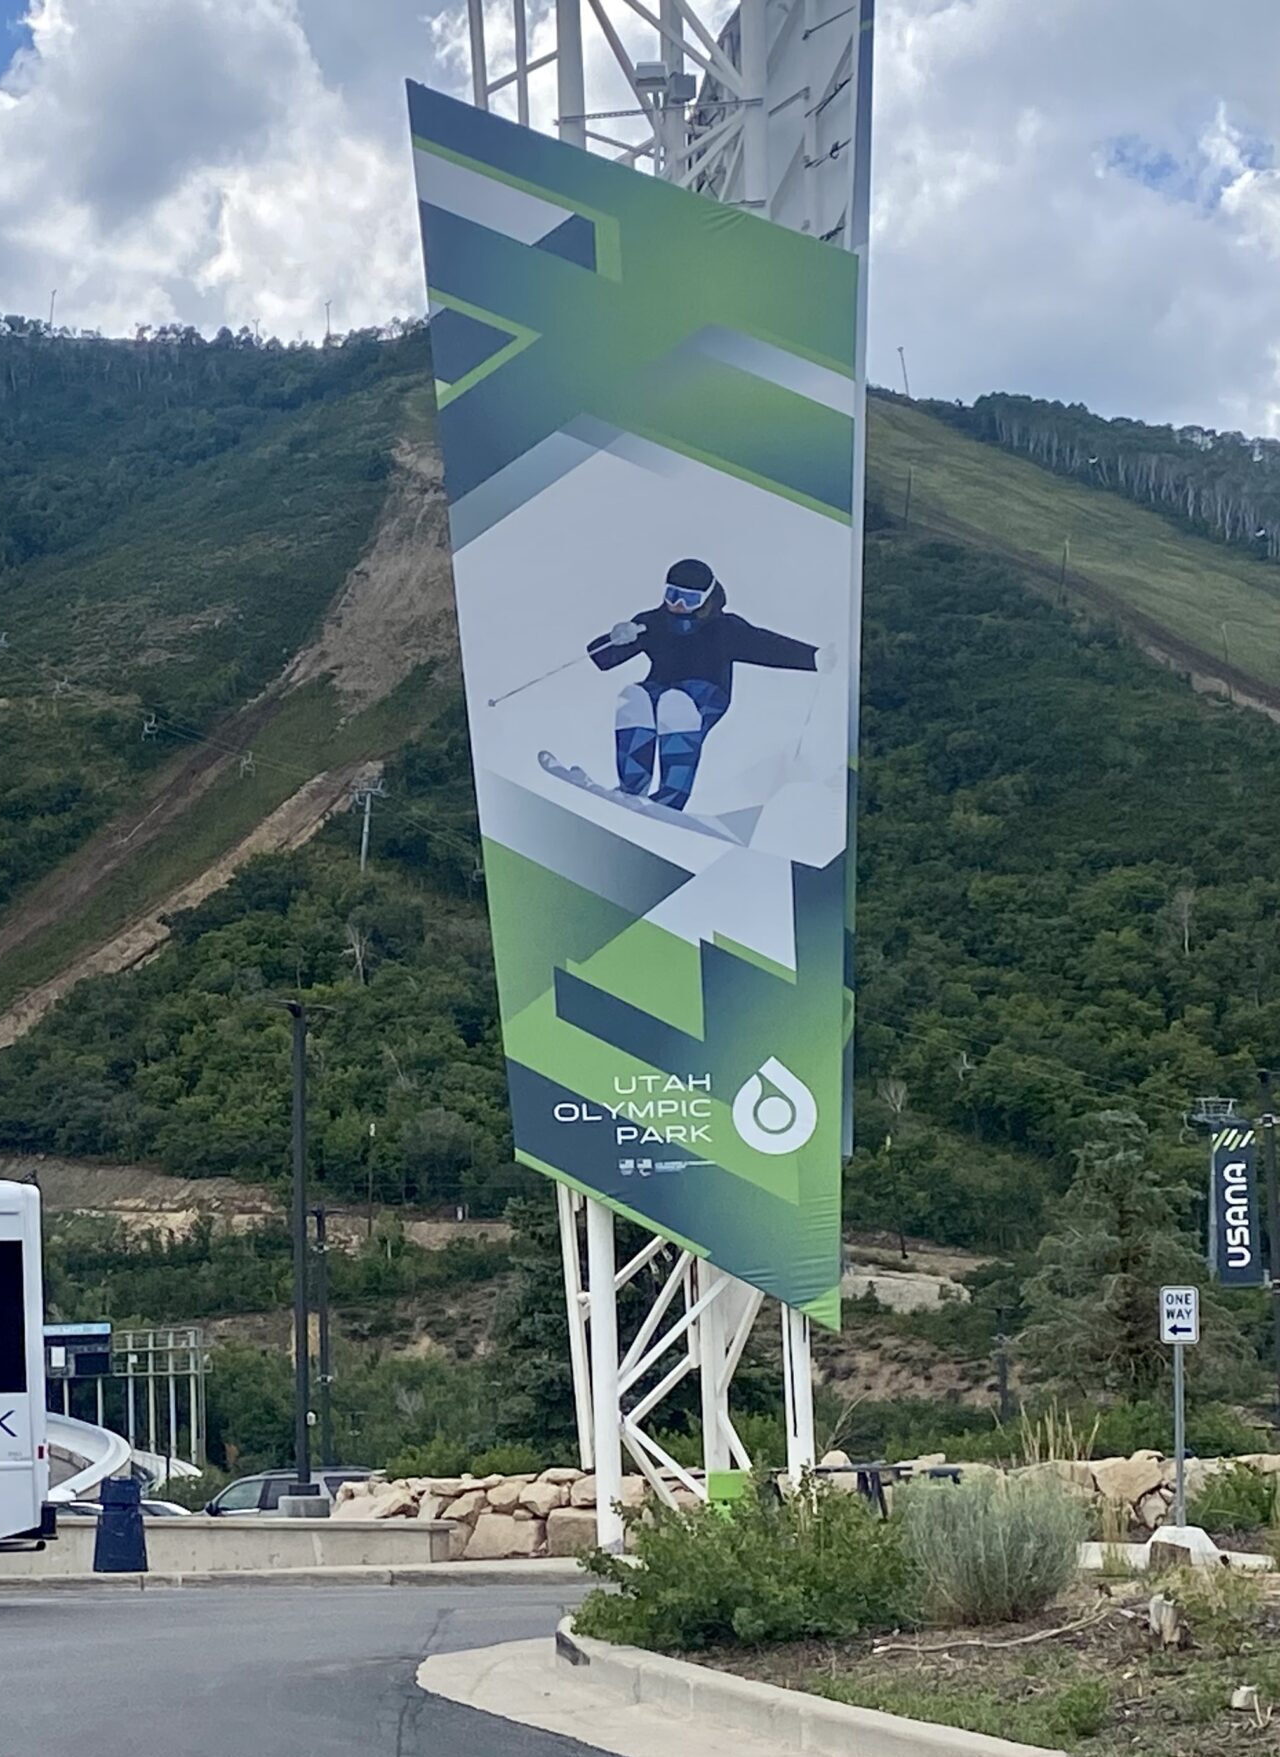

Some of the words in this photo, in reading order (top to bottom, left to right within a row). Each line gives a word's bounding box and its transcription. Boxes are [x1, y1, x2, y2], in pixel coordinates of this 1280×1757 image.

[613, 1073, 711, 1095] UTAH
[553, 1099, 712, 1122] OLYMPIC
[616, 1125, 713, 1145] PARK
[1223, 1161, 1251, 1268] USANA
[1166, 1293, 1192, 1305] ONE
[1166, 1308, 1193, 1320] WAY
